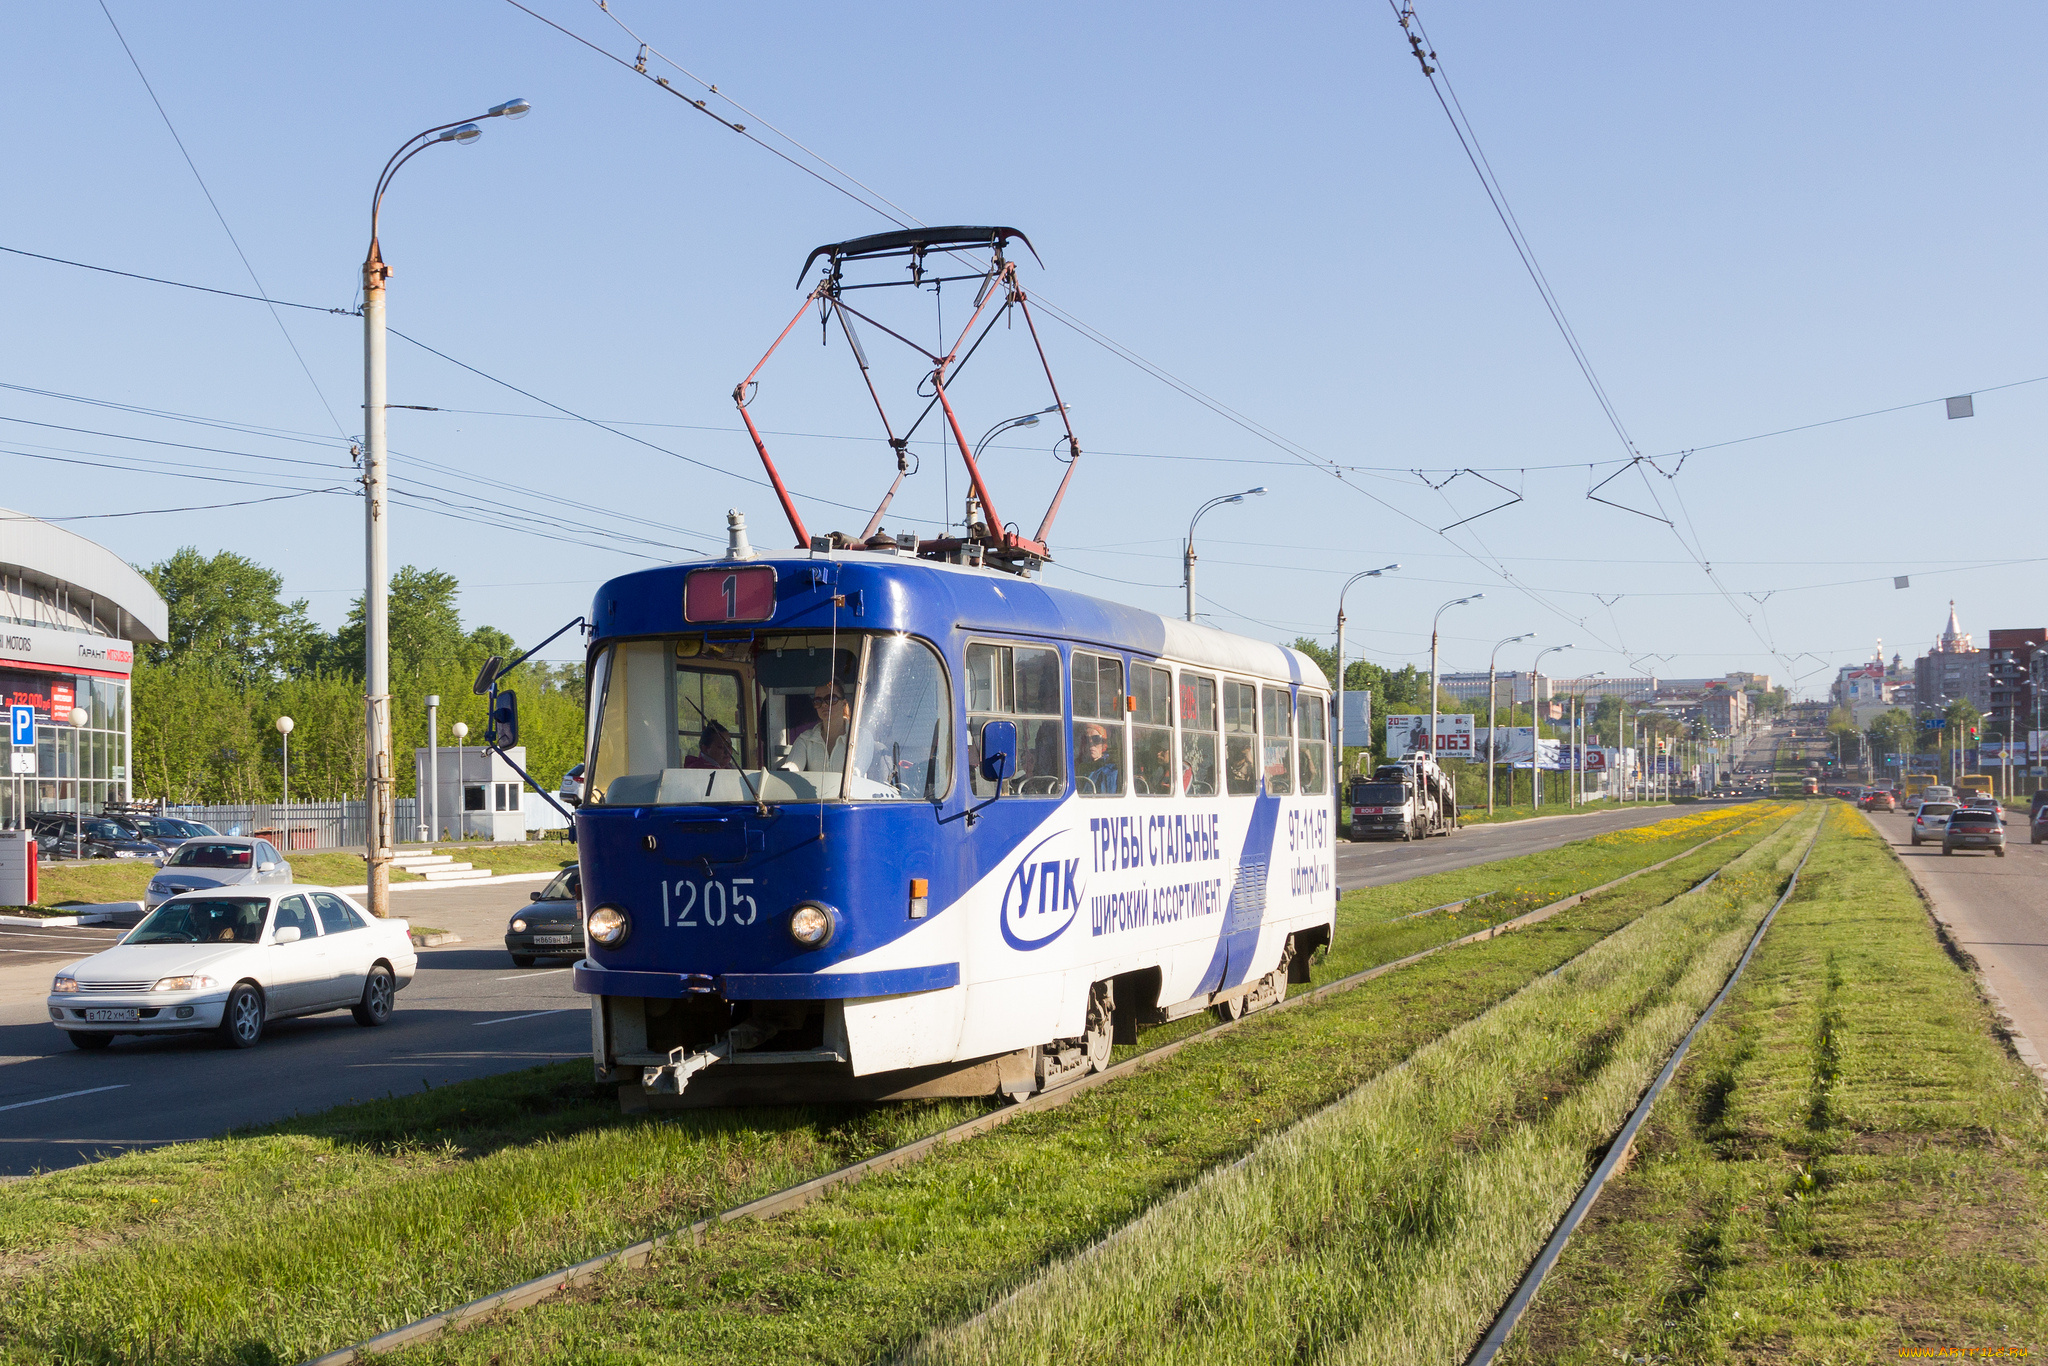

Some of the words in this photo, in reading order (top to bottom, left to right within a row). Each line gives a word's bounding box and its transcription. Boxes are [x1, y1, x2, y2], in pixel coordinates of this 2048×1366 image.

[722, 575, 737, 619] 1
[6, 635, 31, 652] MOTORS
[16, 710, 31, 741] P
[1387, 717, 1400, 726] 20
[705, 770, 716, 797] 1
[1090, 815, 1144, 873] ТРУБЫ
[1148, 813, 1220, 867] СТАЛЬНЫЕ
[1288, 808, 1328, 852] 97-11-97
[1017, 857, 1080, 919] УПК
[1291, 854, 1330, 905] udmpk.ru
[661, 878, 757, 927] 1205
[1091, 879, 1149, 937] ШИРОКИЙ
[1152, 878, 1221, 926] АССОРТИМЕНТ
[126, 1009, 135, 1018] 18
